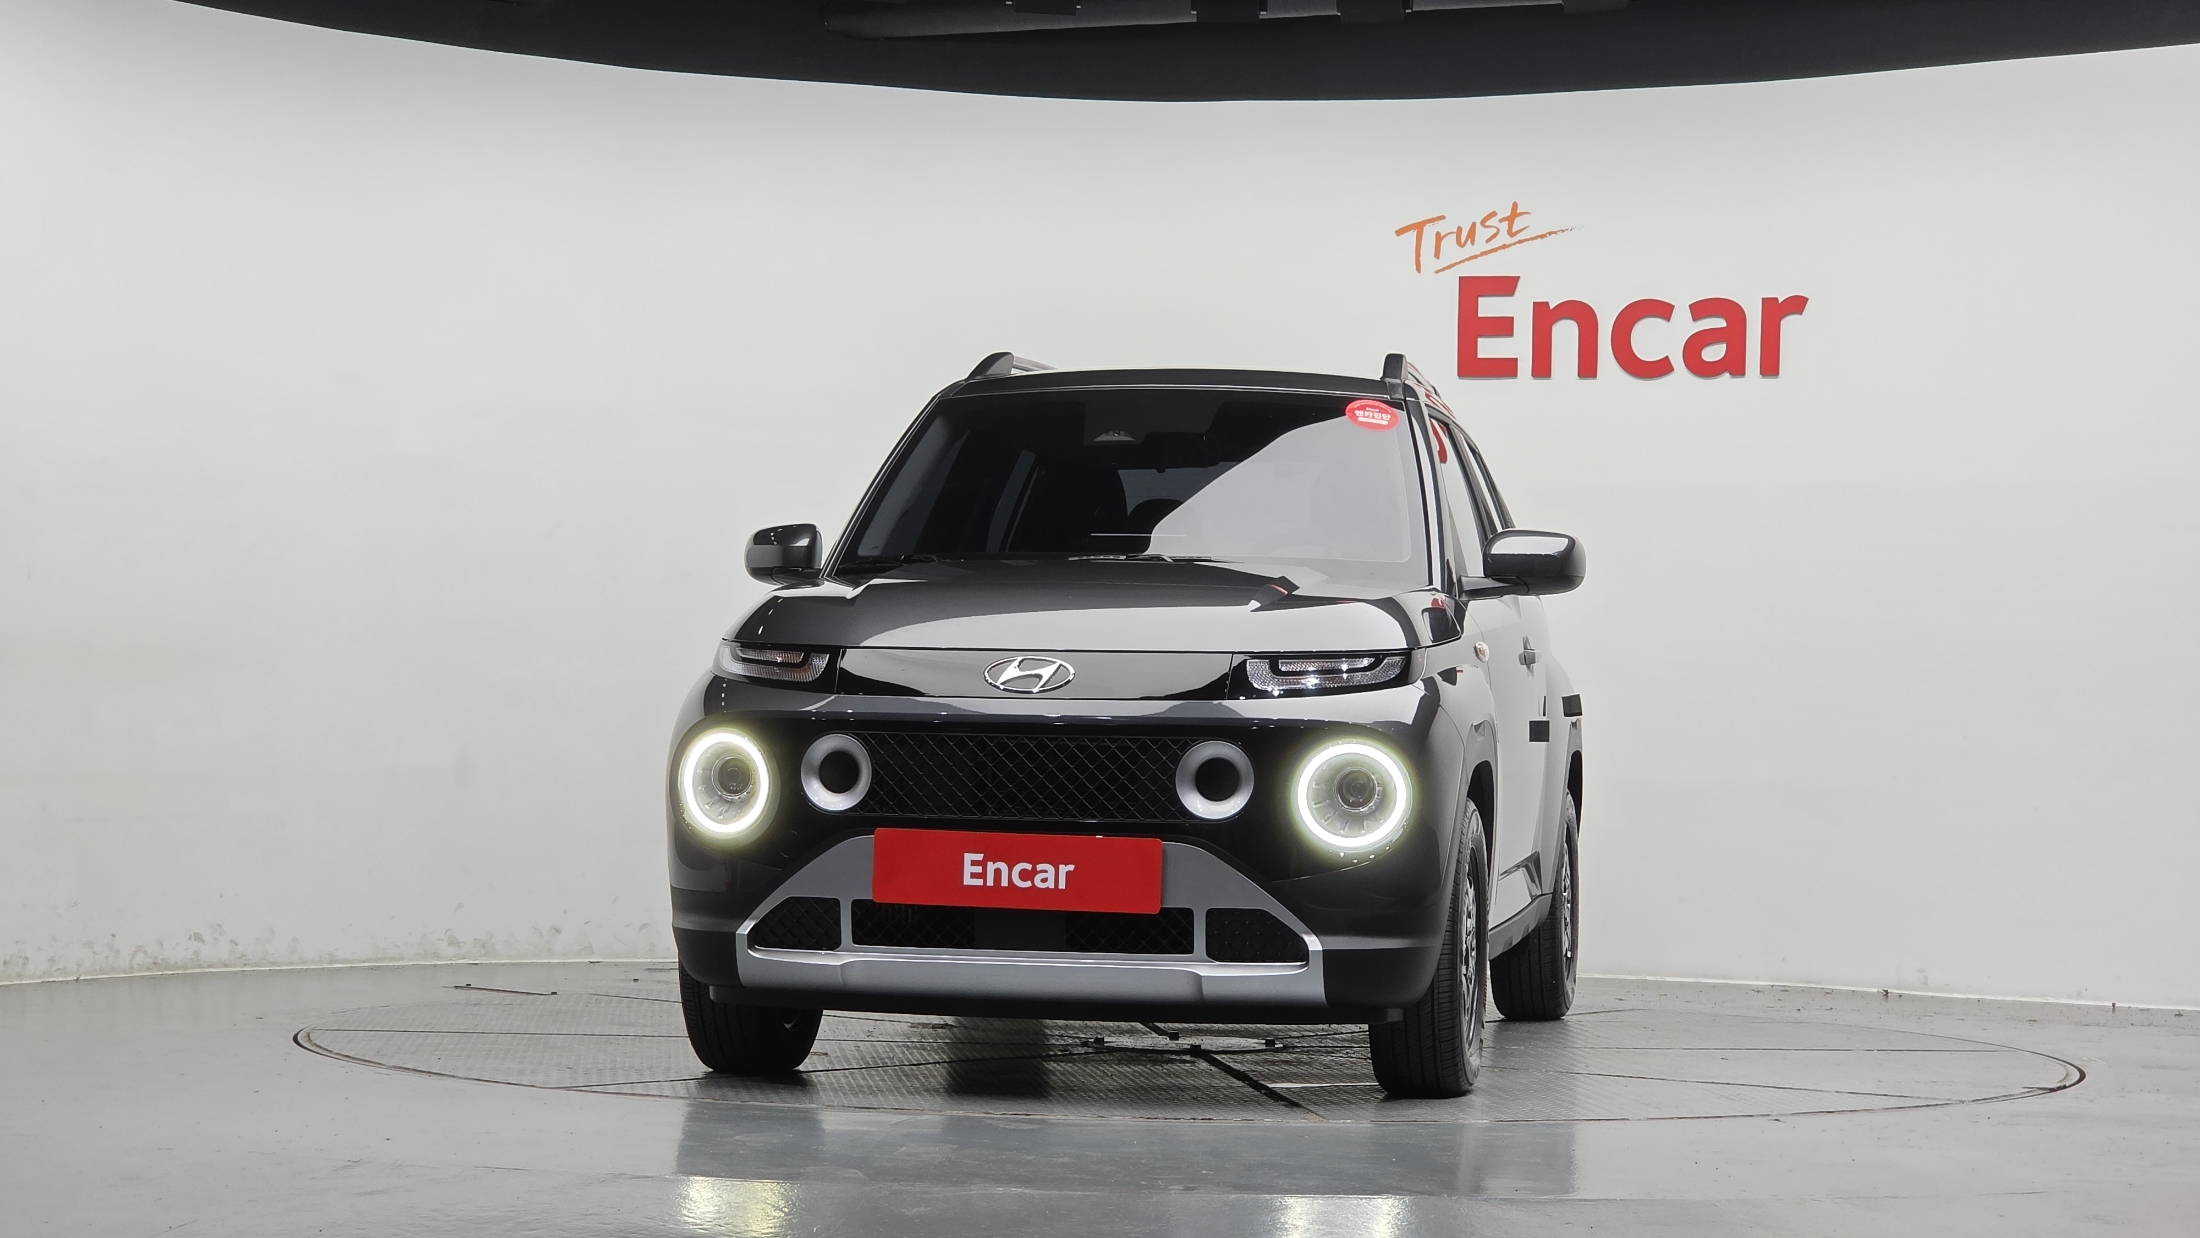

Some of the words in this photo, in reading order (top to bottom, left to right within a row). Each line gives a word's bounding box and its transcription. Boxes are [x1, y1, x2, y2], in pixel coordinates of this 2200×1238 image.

[1395, 201, 1531, 274] Trust
[1457, 275, 1809, 379] Encar
[963, 852, 1075, 889] Encar
